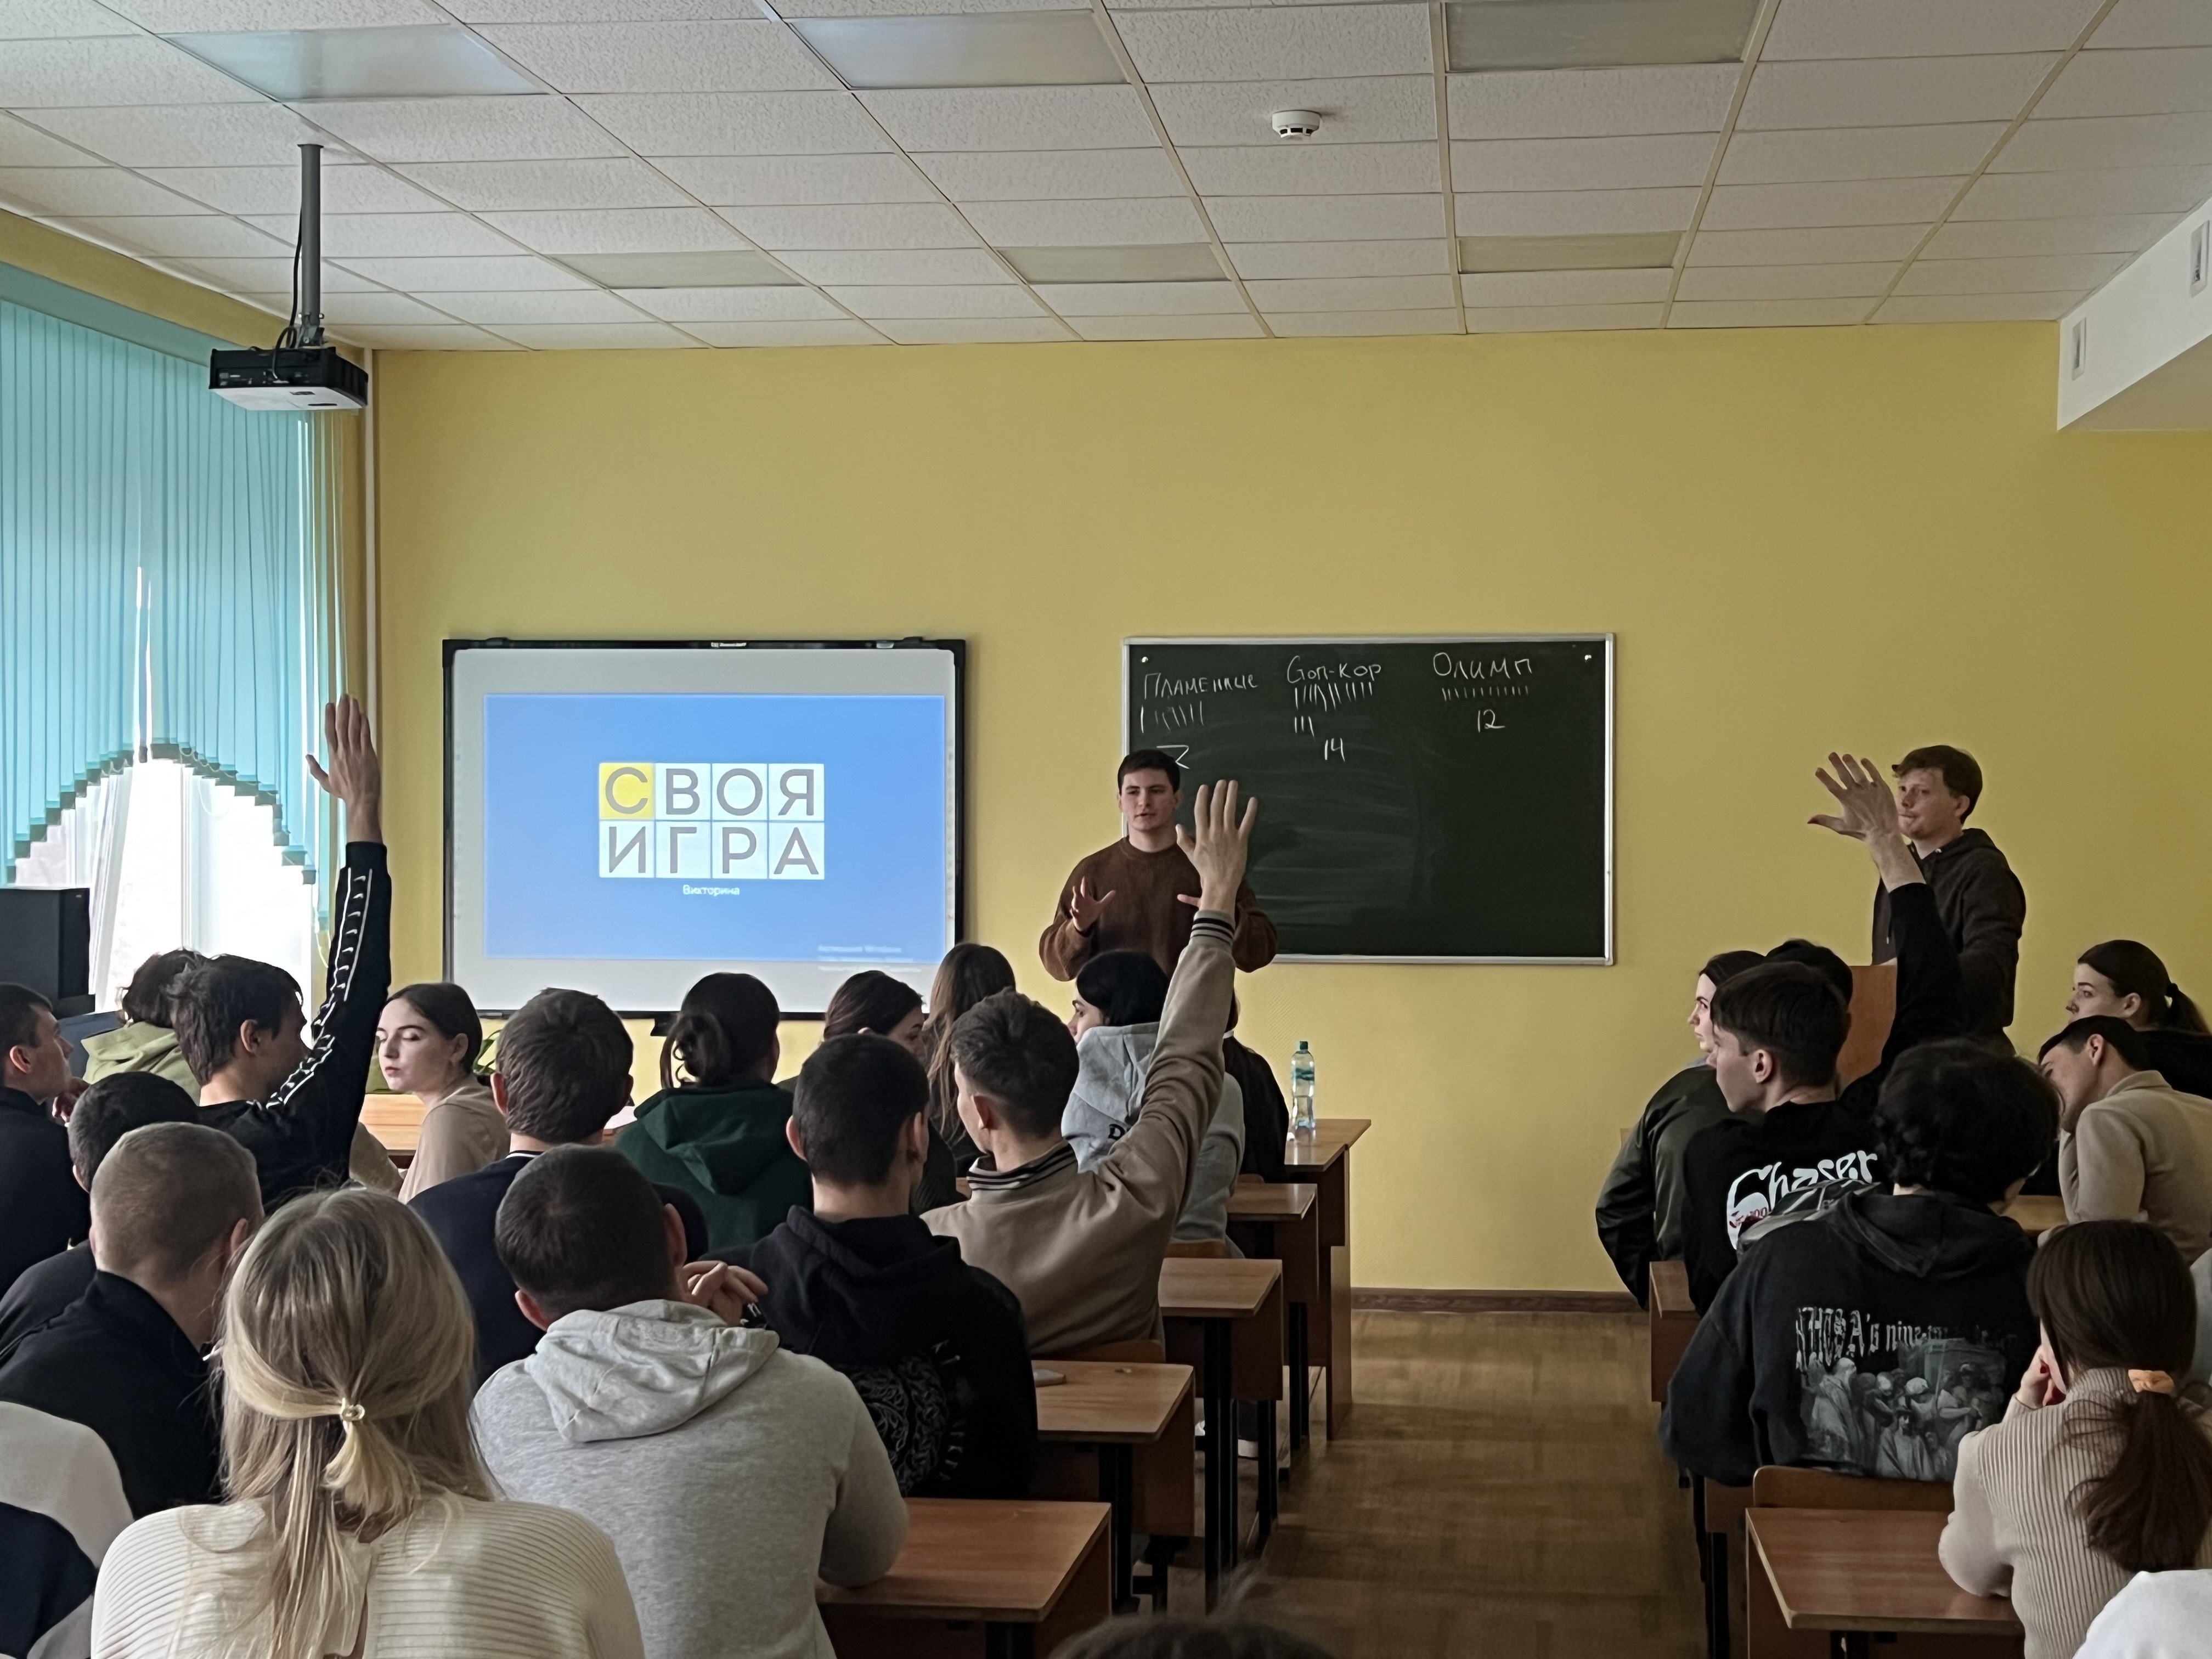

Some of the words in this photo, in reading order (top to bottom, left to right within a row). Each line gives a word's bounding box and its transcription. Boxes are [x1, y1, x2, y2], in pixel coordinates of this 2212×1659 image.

[1477, 709, 1505, 733] 12
[1324, 737, 1345, 761] 14
[605, 766, 815, 816] СВОЯ
[608, 826, 819, 875] ИГРА
[682, 884, 740, 896] Викторина
